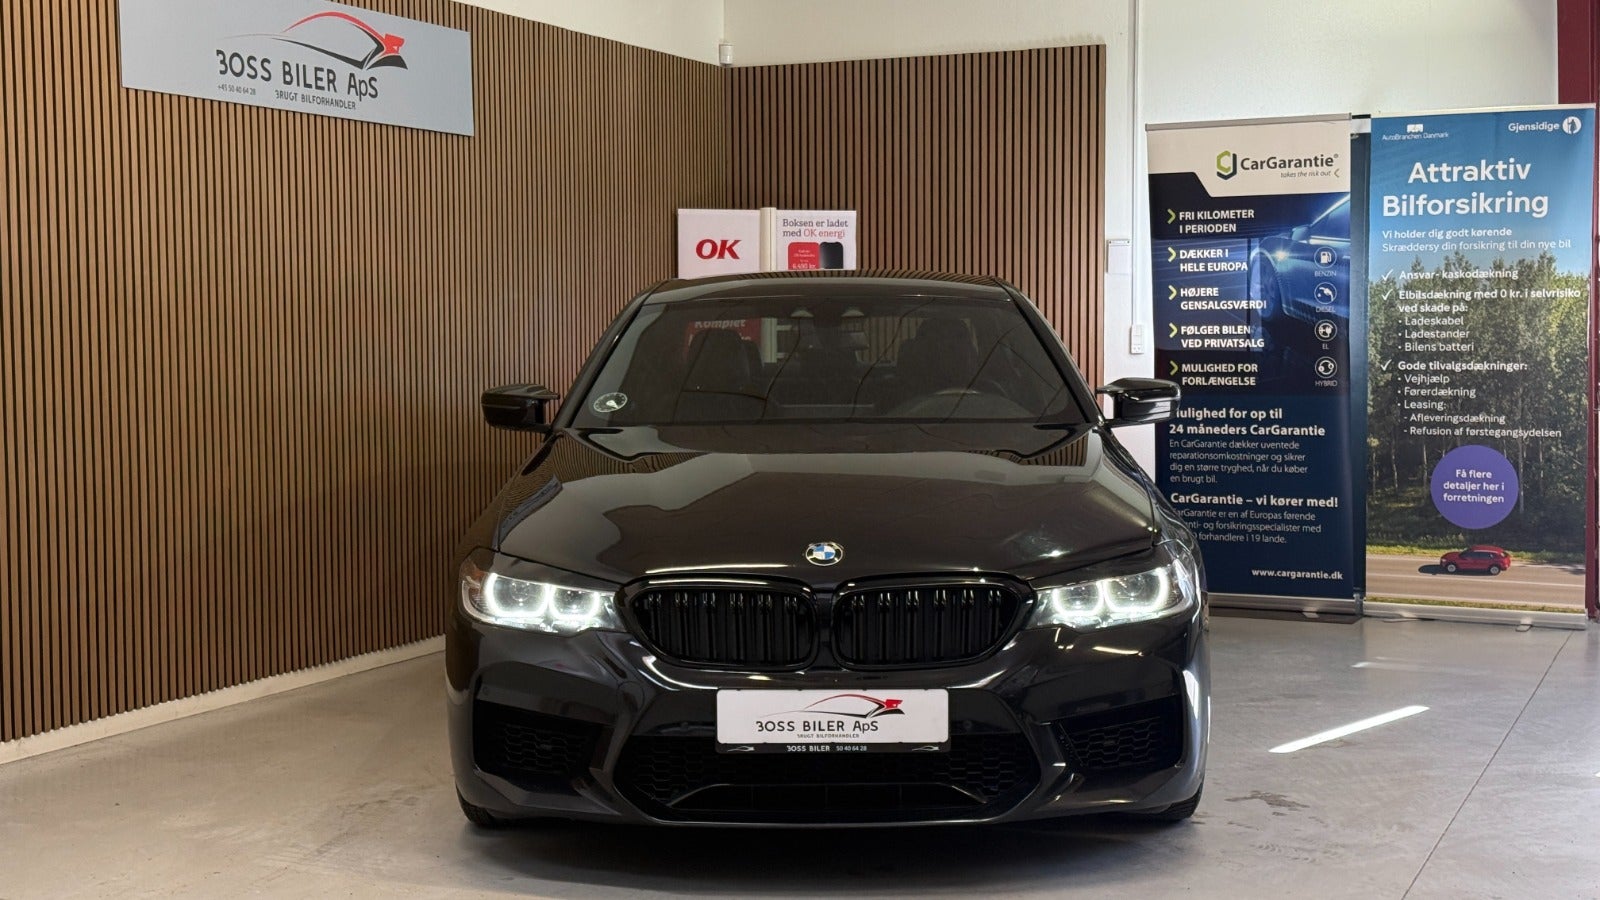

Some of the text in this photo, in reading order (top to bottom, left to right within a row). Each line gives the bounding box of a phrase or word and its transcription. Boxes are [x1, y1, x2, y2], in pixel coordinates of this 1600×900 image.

[282, 61, 337, 93] BILER
[347, 72, 378, 101] ApS
[301, 94, 356, 110] BILFORHANDLER
[1508, 122, 1560, 133] Gjensidige
[1408, 158, 1531, 184] Attraktiv
[1383, 191, 1548, 218] Bilforsikring
[1179, 209, 1255, 221] FRI KILOMETER
[783, 219, 813, 227] Boksen
[827, 219, 848, 227] ladet
[1186, 224, 1237, 233] PERIODEN
[1382, 228, 1512, 239] Vi holder dig godt kørende
[783, 229, 845, 239] med OK energi
[696, 239, 741, 260] OK
[1382, 239, 1571, 254] Skræddersy din forsikring til din nye bil
[1180, 249, 1223, 259] DÆKKER
[1180, 262, 1248, 272] HELE EUROPA
[1399, 270, 1518, 280] Ansvar- kaskodækning
[1180, 288, 1219, 298] HØJERE
[1399, 290, 1471, 301] Elbilsdækning
[1474, 290, 1497, 298] med
[1509, 290, 1522, 298] kr.
[1530, 289, 1581, 298] selvrisiko
[1181, 300, 1267, 310] GENSALGSVÆRDI
[1399, 304, 1468, 314] ved skade på:
[1405, 317, 1464, 326] Ladeskabel
[1181, 325, 1250, 335] FØLGER BILEN
[1405, 330, 1470, 338] Ladestander
[1181, 339, 1265, 348] VED PRIVATSALG
[1405, 342, 1474, 351] Bilens batteri
[1182, 364, 1258, 373] MULIGHED FOR
[1398, 361, 1528, 372] Gode tilvalgsdækninger:
[1182, 377, 1256, 386] FORLÆNGELSE
[1404, 374, 1450, 385] Vejhjælp
[1404, 387, 1476, 398] Førerdækning
[1404, 400, 1447, 410] Leasing:
[1177, 408, 1282, 421] ulighed for op til
[1410, 414, 1506, 424] Afleveringsdækning
[1169, 424, 1325, 436] 24 måneders CarGarantie
[1410, 427, 1561, 438] Refusion af førstegangsydelsen
[1181, 440, 1227, 448] CarGarantie
[1229, 440, 1258, 449] dækker
[1261, 441, 1300, 450] uventede
[1169, 452, 1268, 462] reparationsomkostninger
[1169, 464, 1183, 473] dig
[1197, 464, 1219, 472] større
[1221, 464, 1255, 474] tryghed,
[1256, 464, 1269, 472] når
[1271, 464, 1282, 473] du
[1284, 465, 1307, 473] køber
[1455, 469, 1492, 479] Få flere
[1182, 475, 1204, 485] brugt
[1206, 475, 1217, 483] bil.
[1443, 481, 1480, 492] detaljer
[1483, 482, 1499, 491] her
[1170, 493, 1243, 505] CarGarantie
[1256, 495, 1267, 506] vi
[1270, 495, 1303, 507] kører
[1307, 497, 1338, 507] med!
[1443, 493, 1504, 504] forretningen
[1240, 510, 1250, 518] af
[1250, 511, 1282, 520] Europas
[1284, 512, 1315, 520] førende
[1215, 522, 1300, 532] forsikringsspecialister
[1302, 524, 1322, 533] med
[1199, 533, 1244, 542] forhandlere
[1251, 534, 1260, 542] 19
[1262, 535, 1287, 543] lande.
[1252, 569, 1343, 580] www.cargarantie.dk
[803, 721, 844, 732] BILER
[853, 721, 879, 734] ApS
